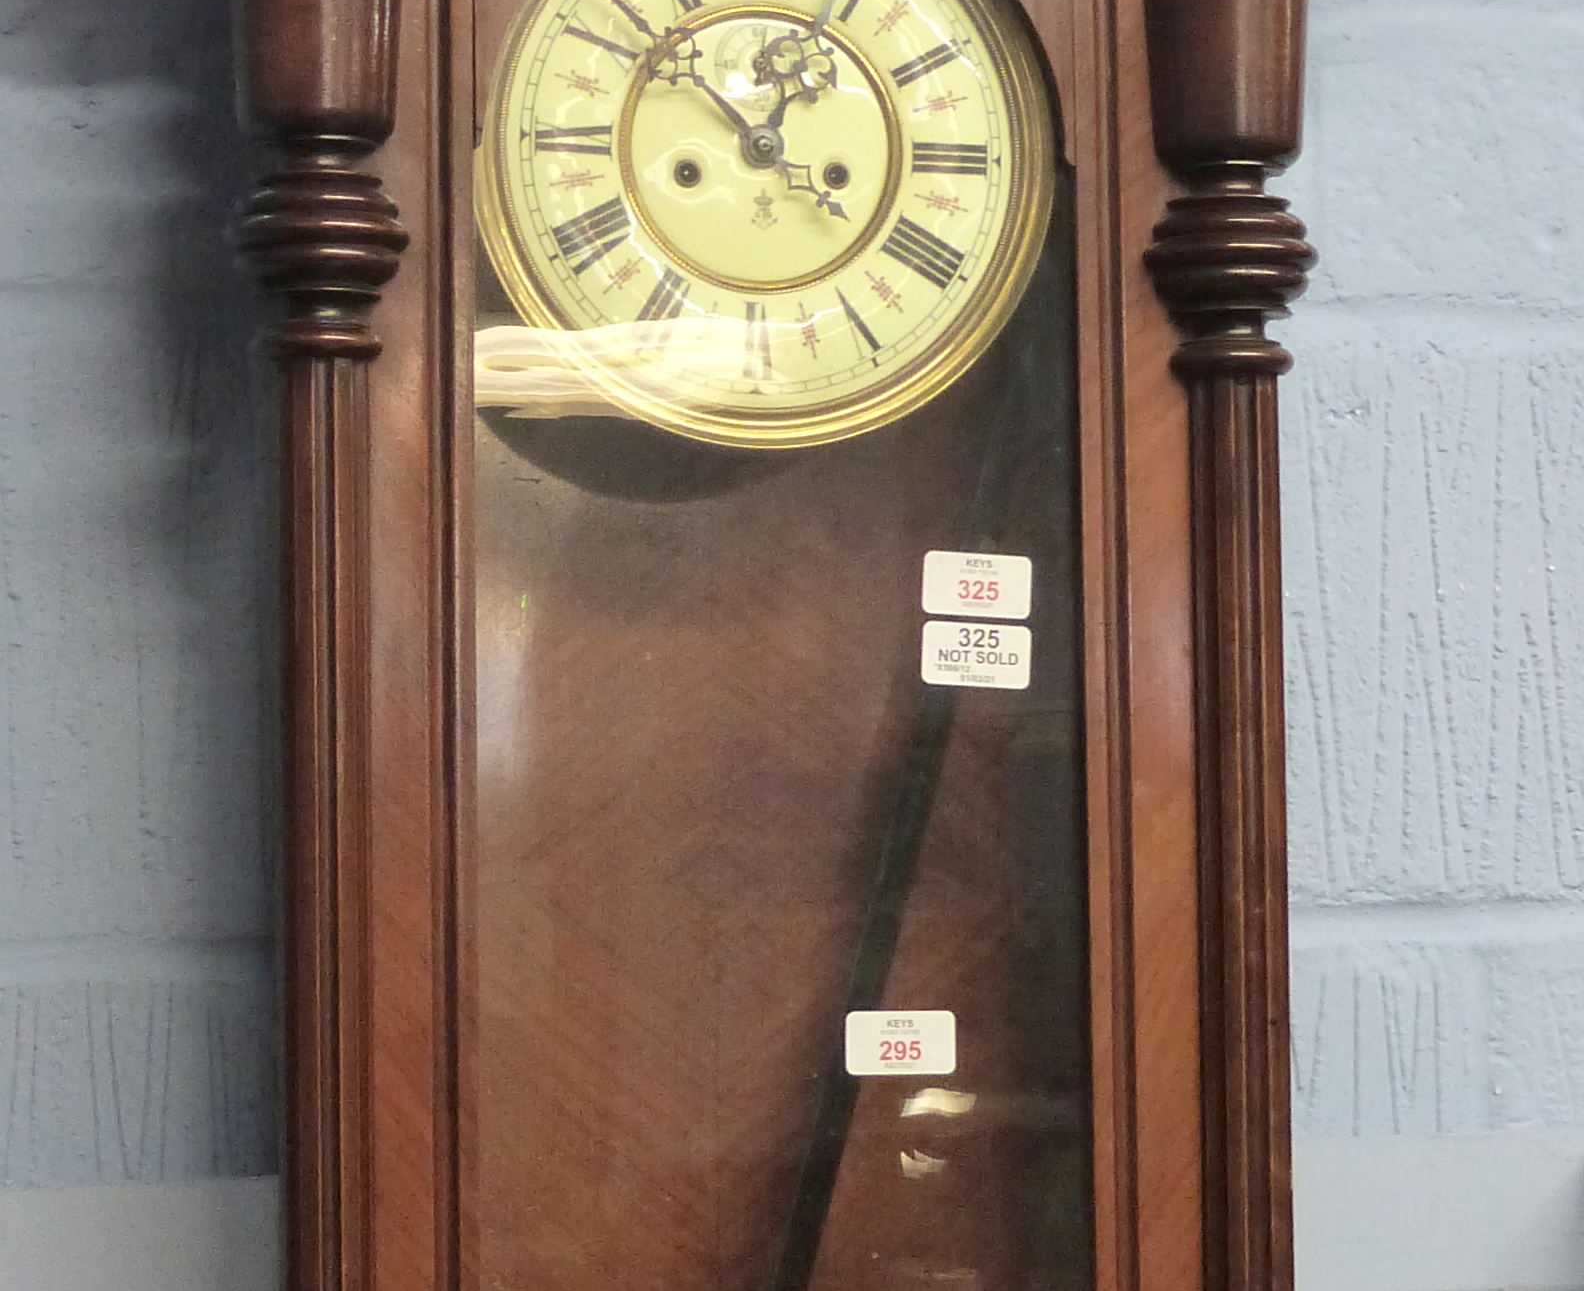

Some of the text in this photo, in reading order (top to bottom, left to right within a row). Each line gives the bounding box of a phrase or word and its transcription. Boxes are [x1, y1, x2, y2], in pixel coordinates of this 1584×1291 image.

[965, 558, 993, 569] KEYS
[957, 579, 1000, 601] 325
[958, 627, 1000, 649] 325
[938, 649, 1019, 666] NOT SOLD
[886, 1019, 915, 1029] KEYS
[878, 1040, 922, 1061] 295
